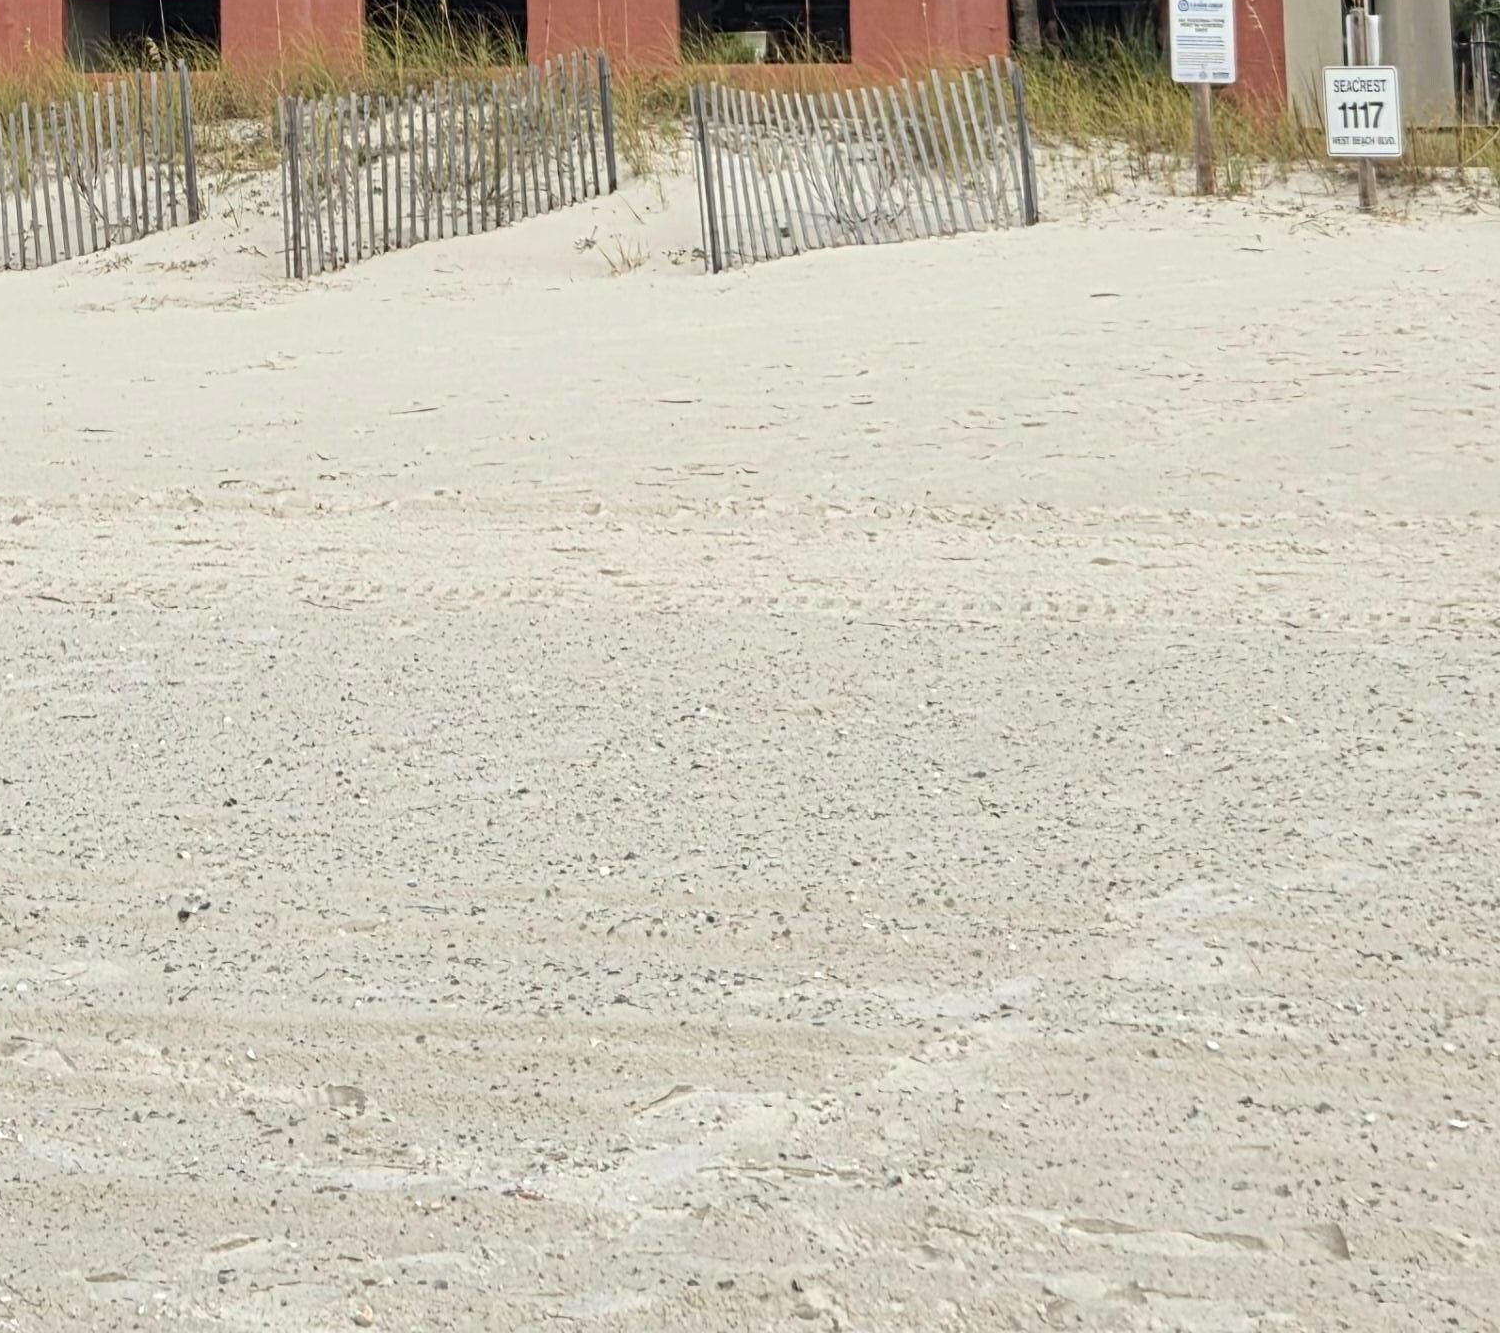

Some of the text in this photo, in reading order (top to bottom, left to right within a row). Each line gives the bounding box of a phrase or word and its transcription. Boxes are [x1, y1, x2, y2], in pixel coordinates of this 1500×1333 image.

[1333, 79, 1386, 93] SEACREST
[1338, 102, 1383, 128] 1117
[1332, 136, 1349, 145] WEST
[1352, 136, 1375, 145] BEACH
